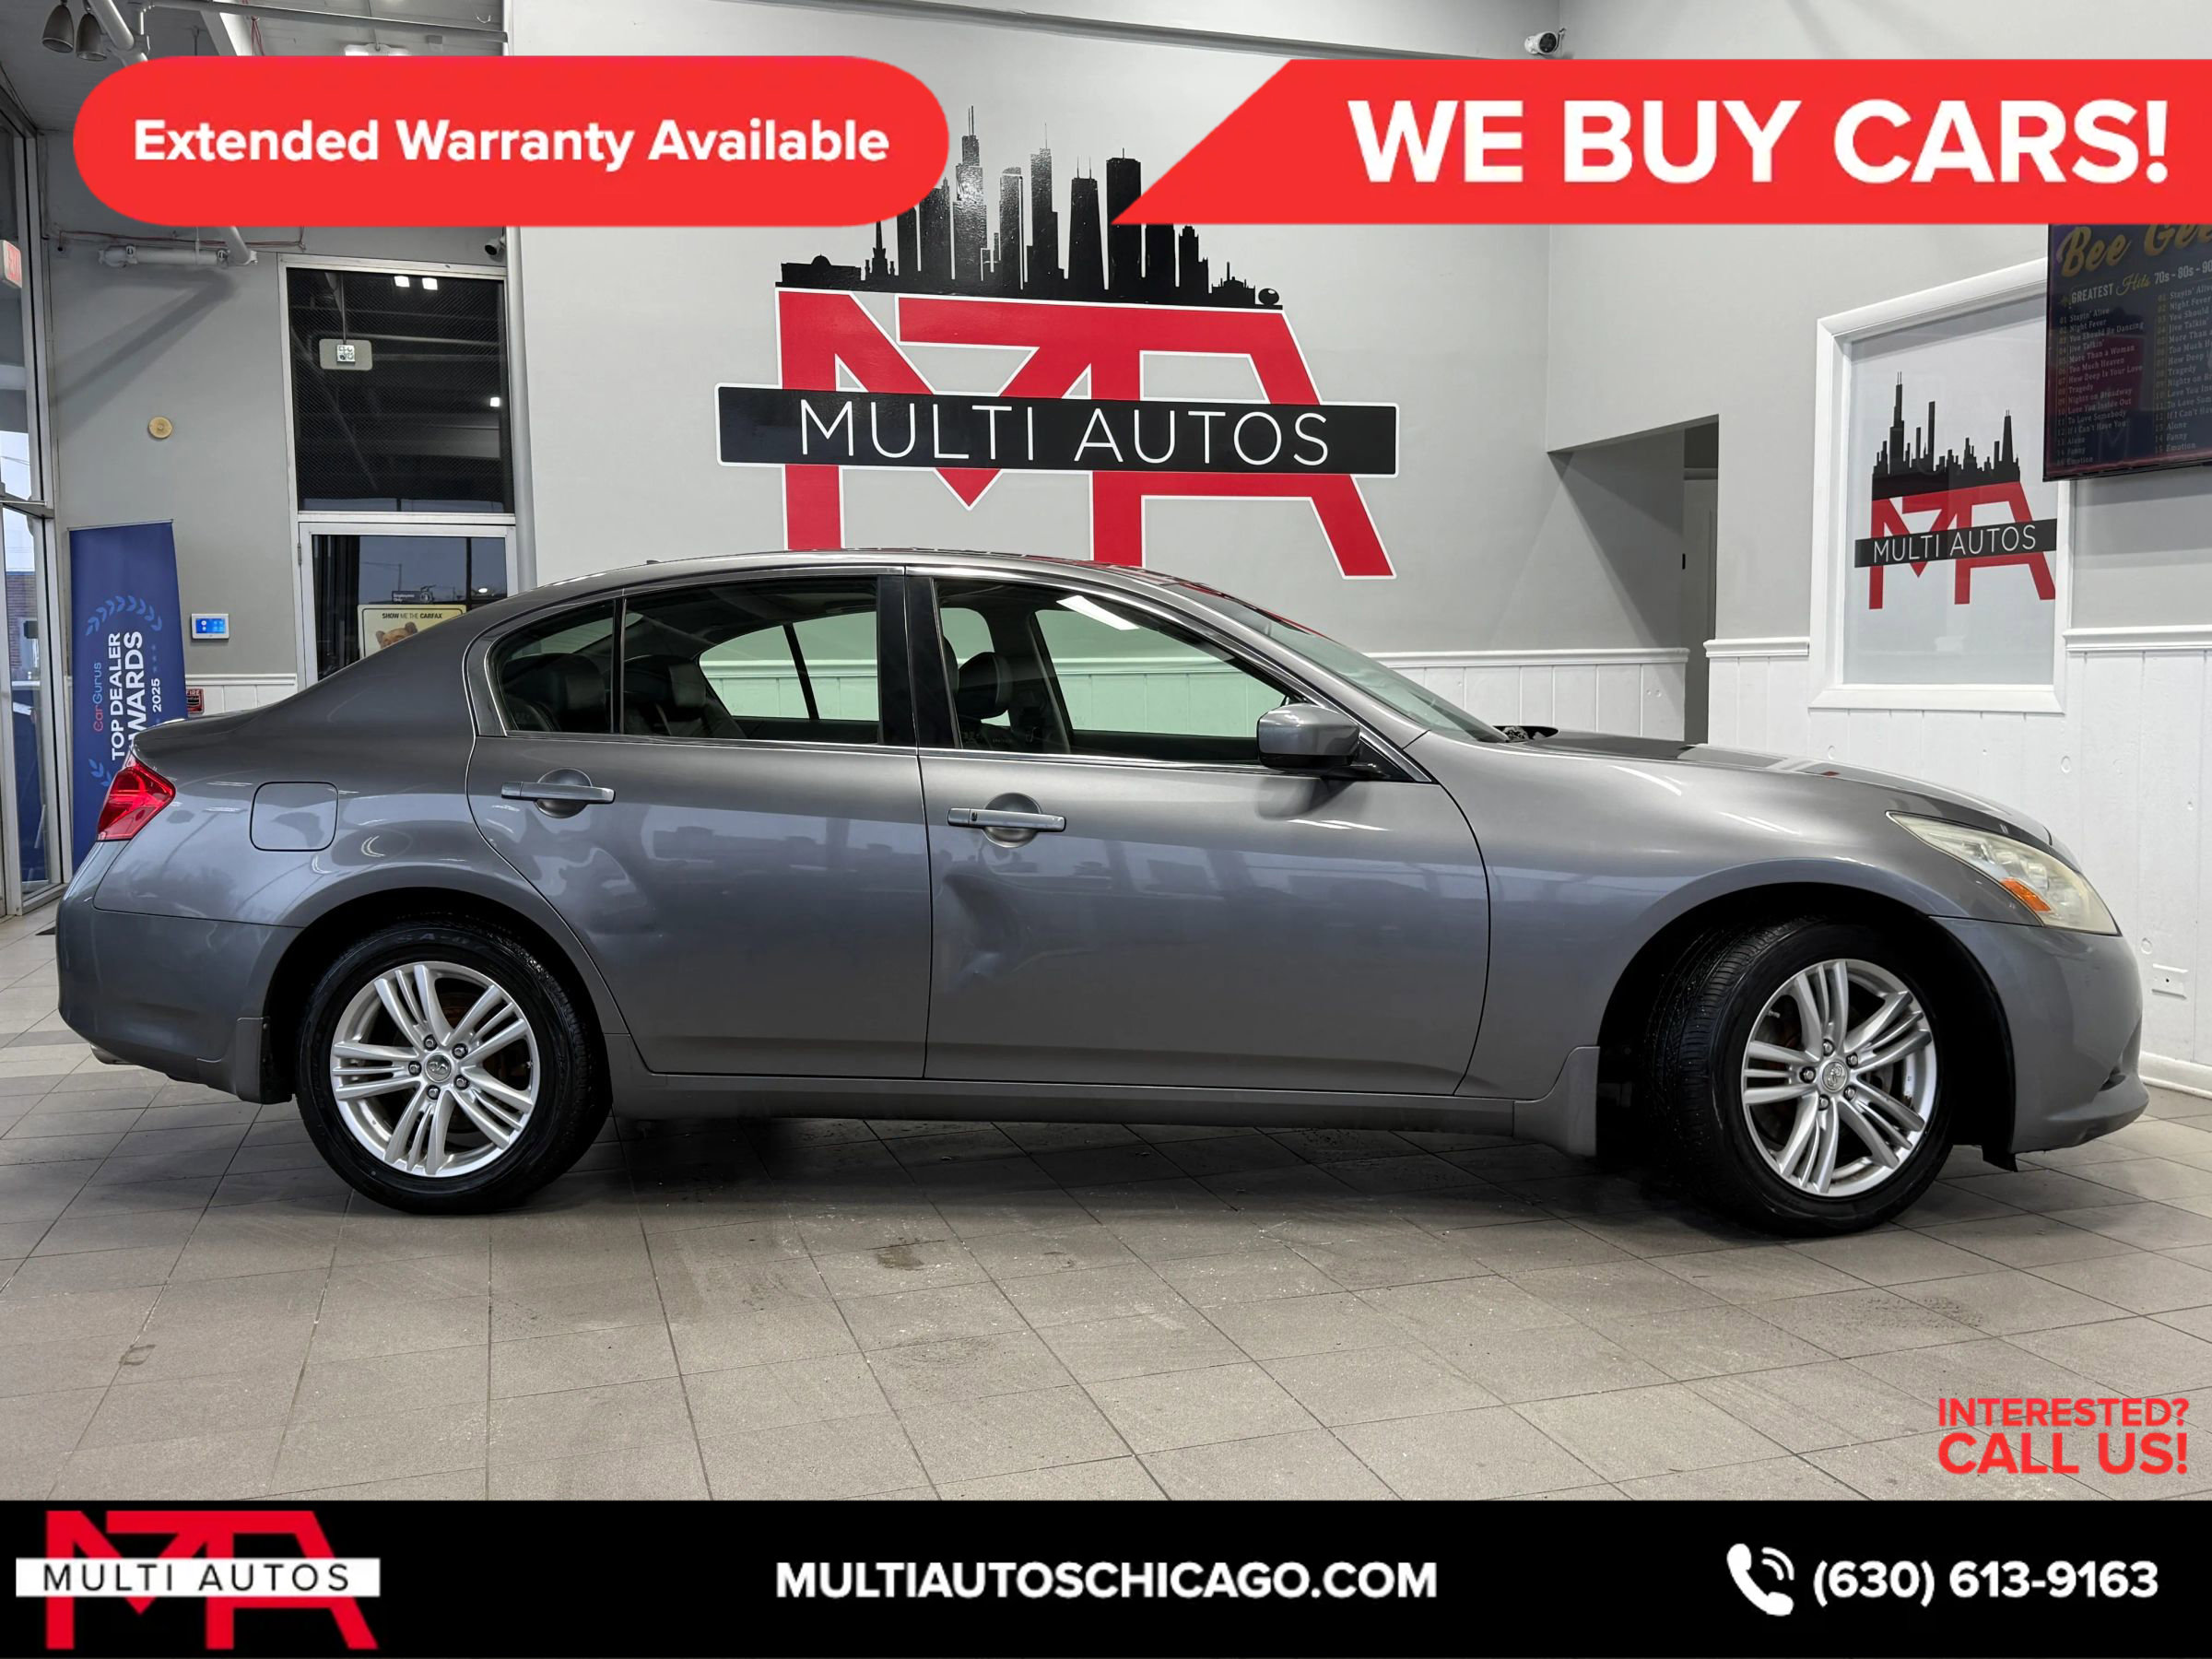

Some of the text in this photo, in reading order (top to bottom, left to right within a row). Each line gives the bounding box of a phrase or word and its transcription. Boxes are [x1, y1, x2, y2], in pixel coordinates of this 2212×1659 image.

[2056, 226, 2133, 277] Bee
[2071, 283, 2114, 304] GREATEST
[2116, 273, 2151, 296] Hits
[2154, 271, 2170, 285] 70s
[2178, 265, 2194, 279] 80s
[2082, 362, 2100, 371] Much
[2100, 357, 2124, 368] Heaven
[2087, 350, 2103, 359] Than
[2110, 345, 2136, 355] Woman
[2168, 363, 2197, 376] Tragedy
[2068, 383, 2094, 394] Tragedy
[800, 399, 1329, 465] MULTI AUTOS
[1874, 524, 2036, 563] MULTI AUTOS
[92, 662, 104, 732] CarGurus
[108, 632, 125, 761] TOP DEALER
[124, 631, 147, 748] WARDS
[151, 677, 162, 713] 2025
